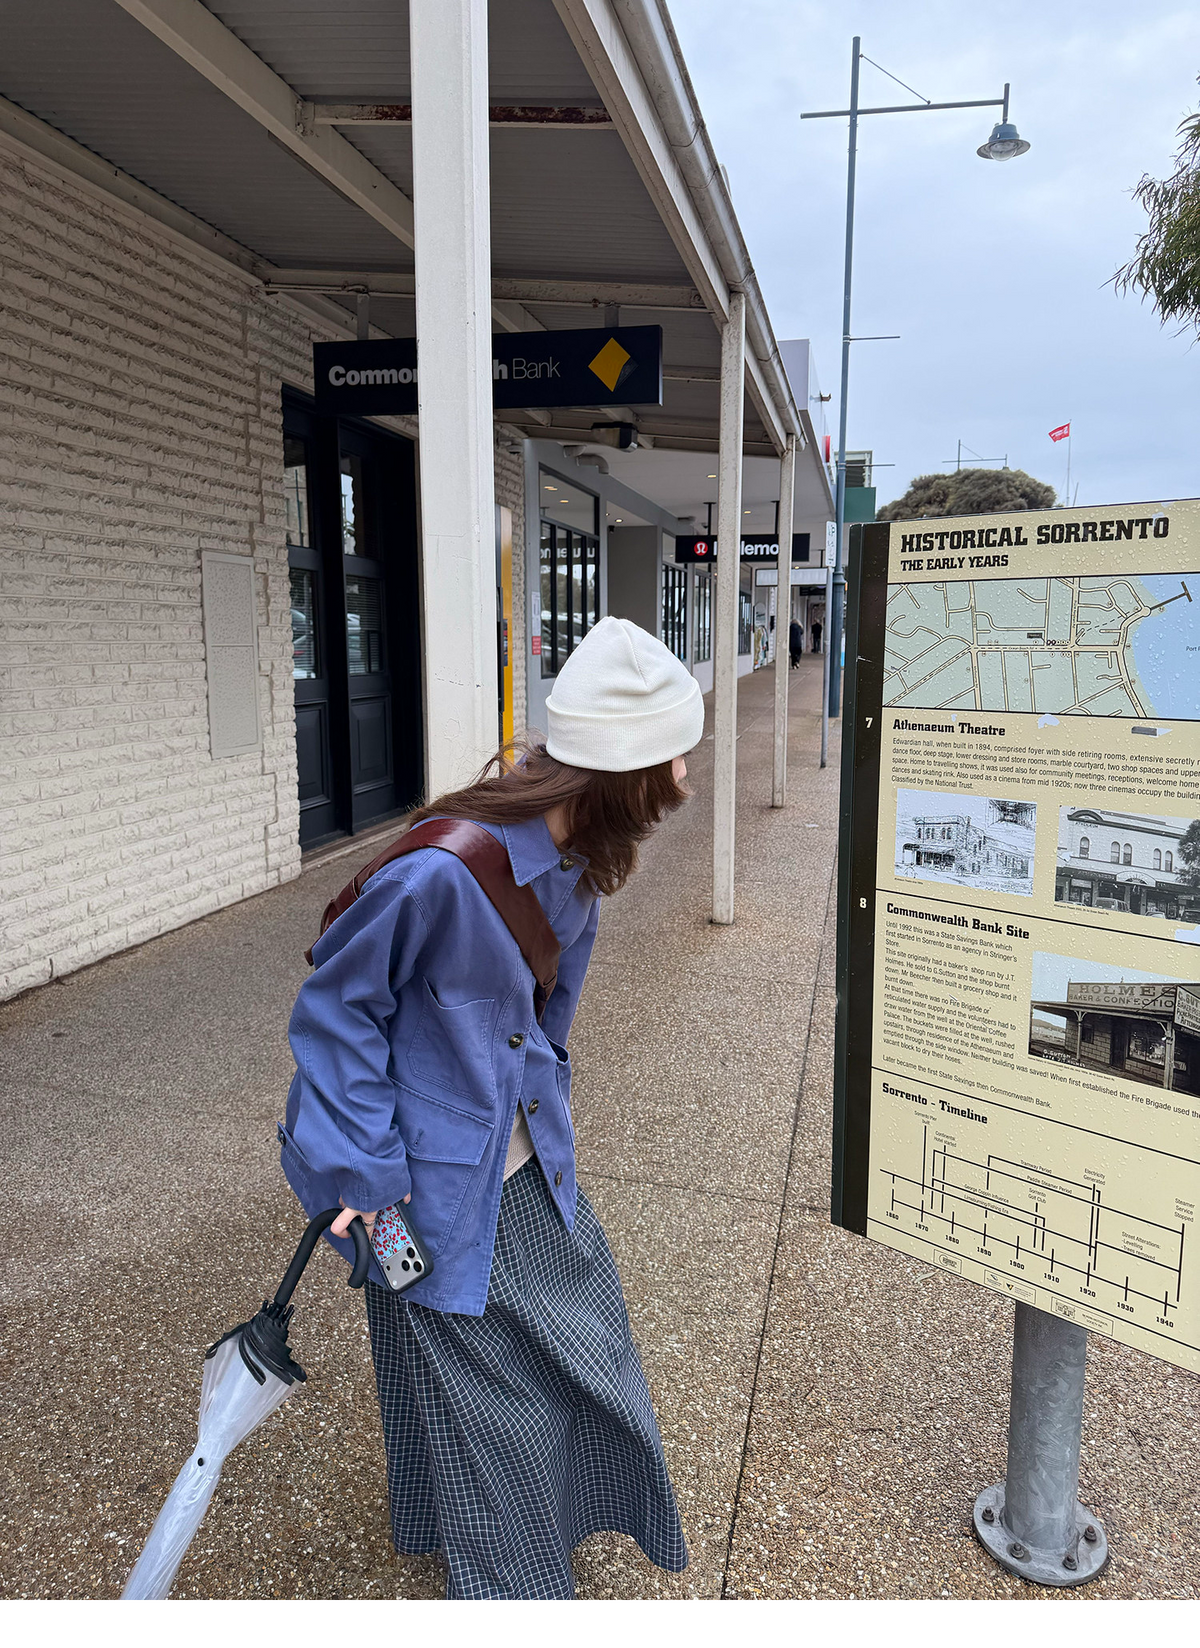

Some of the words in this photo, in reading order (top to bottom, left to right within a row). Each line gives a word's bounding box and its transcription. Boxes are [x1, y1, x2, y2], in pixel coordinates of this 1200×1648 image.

[512, 357, 561, 379] Bank
[900, 526, 1028, 553] HISTORICAL
[1036, 517, 1170, 545] SORRENTO
[714, 541, 780, 556] llemo
[900, 559, 924, 571] THE
[926, 557, 965, 570] EARLY
[968, 555, 1009, 568] YEARS
[865, 717, 873, 728] 7
[893, 719, 954, 733] Athenaeum
[958, 722, 1005, 736] Theatre
[892, 737, 921, 745] Edwardian
[975, 743, 992, 751] 1894,
[1027, 746, 1044, 755] foyer
[1077, 750, 1102, 760] retiring
[1103, 753, 1127, 761] rooms,
[1129, 754, 1163, 763] extensive
[1165, 757, 1195, 766] secretly
[909, 748, 922, 756] floor,
[922, 749, 937, 757] deep
[937, 751, 954, 759] stage,
[972, 753, 997, 762] dressing
[1049, 759, 1072, 767] marble
[1073, 761, 1105, 770] courtyard,
[1120, 764, 1138, 773] shop
[1139, 766, 1163, 774] spaces
[932, 759, 958, 769] travelling
[959, 762, 979, 770] shows,
[1038, 769, 1073, 779] community
[1074, 772, 1106, 781] meetings,
[1107, 774, 1144, 784] receptions,
[1145, 777, 1177, 786] welcome
[1179, 780, 1200, 788] home
[891, 774, 916, 783] Classified
[916, 777, 924, 785] by
[934, 779, 957, 787] National
[958, 780, 972, 789] Trust.
[922, 768, 942, 777] skating
[1021, 776, 1036, 784] from
[1051, 779, 1072, 788] 1920s;
[1089, 783, 1106, 791] three
[1107, 785, 1136, 794] cinemas
[1137, 788, 1162, 797] occupy
[860, 898, 867, 908] 8
[887, 903, 968, 928] Commonwealth
[972, 918, 1002, 934] Bank
[1006, 924, 1029, 939] Site
[1080, 985, 1175, 997] HOLMES
[883, 1028, 903, 1038] emptied
[904, 1033, 924, 1045] through
[925, 1039, 934, 1047] the
[947, 1046, 970, 1057] window.
[970, 1051, 991, 1062] Neither
[991, 1057, 1014, 1070] building
[1015, 1064, 1028, 1072] was
[1029, 1068, 1048, 1078] saved!
[1049, 1072, 1067, 1082] When
[1068, 1077, 1080, 1086] first
[1081, 1082, 1118, 1096] established
[1119, 1091, 1130, 1100] the
[1131, 1093, 1144, 1103] Fire
[1145, 1097, 1171, 1111] Brigade
[1172, 1106, 1190, 1115] used
[882, 1082, 927, 1105] Sorrento
[939, 1100, 987, 1124] Timeline
[1021, 1160, 1038, 1170] Tramway
[1039, 1166, 1052, 1174] Period
[1083, 1174, 1105, 1185] Generated
[1085, 1168, 1105, 1179] Electricity
[1029, 1188, 1046, 1197] Sorrento
[1041, 1180, 1058, 1188] Steamer
[1059, 1186, 1072, 1194] Period
[1175, 1198, 1195, 1208] Steamer
[886, 1211, 899, 1221] 1860
[1176, 1205, 1193, 1215] Service
[1174, 1212, 1194, 1222] Stopped
[915, 1223, 929, 1232] 1870
[945, 1234, 960, 1245] 1880
[1122, 1231, 1135, 1240] Street
[977, 1246, 992, 1257] 1890
[1136, 1250, 1155, 1261] removed
[1009, 1260, 1025, 1270] 1900
[1043, 1272, 1060, 1283] 1910
[1079, 1286, 1096, 1298] 1920
[1117, 1301, 1134, 1313] 1930
[1156, 1316, 1174, 1328] 1940
